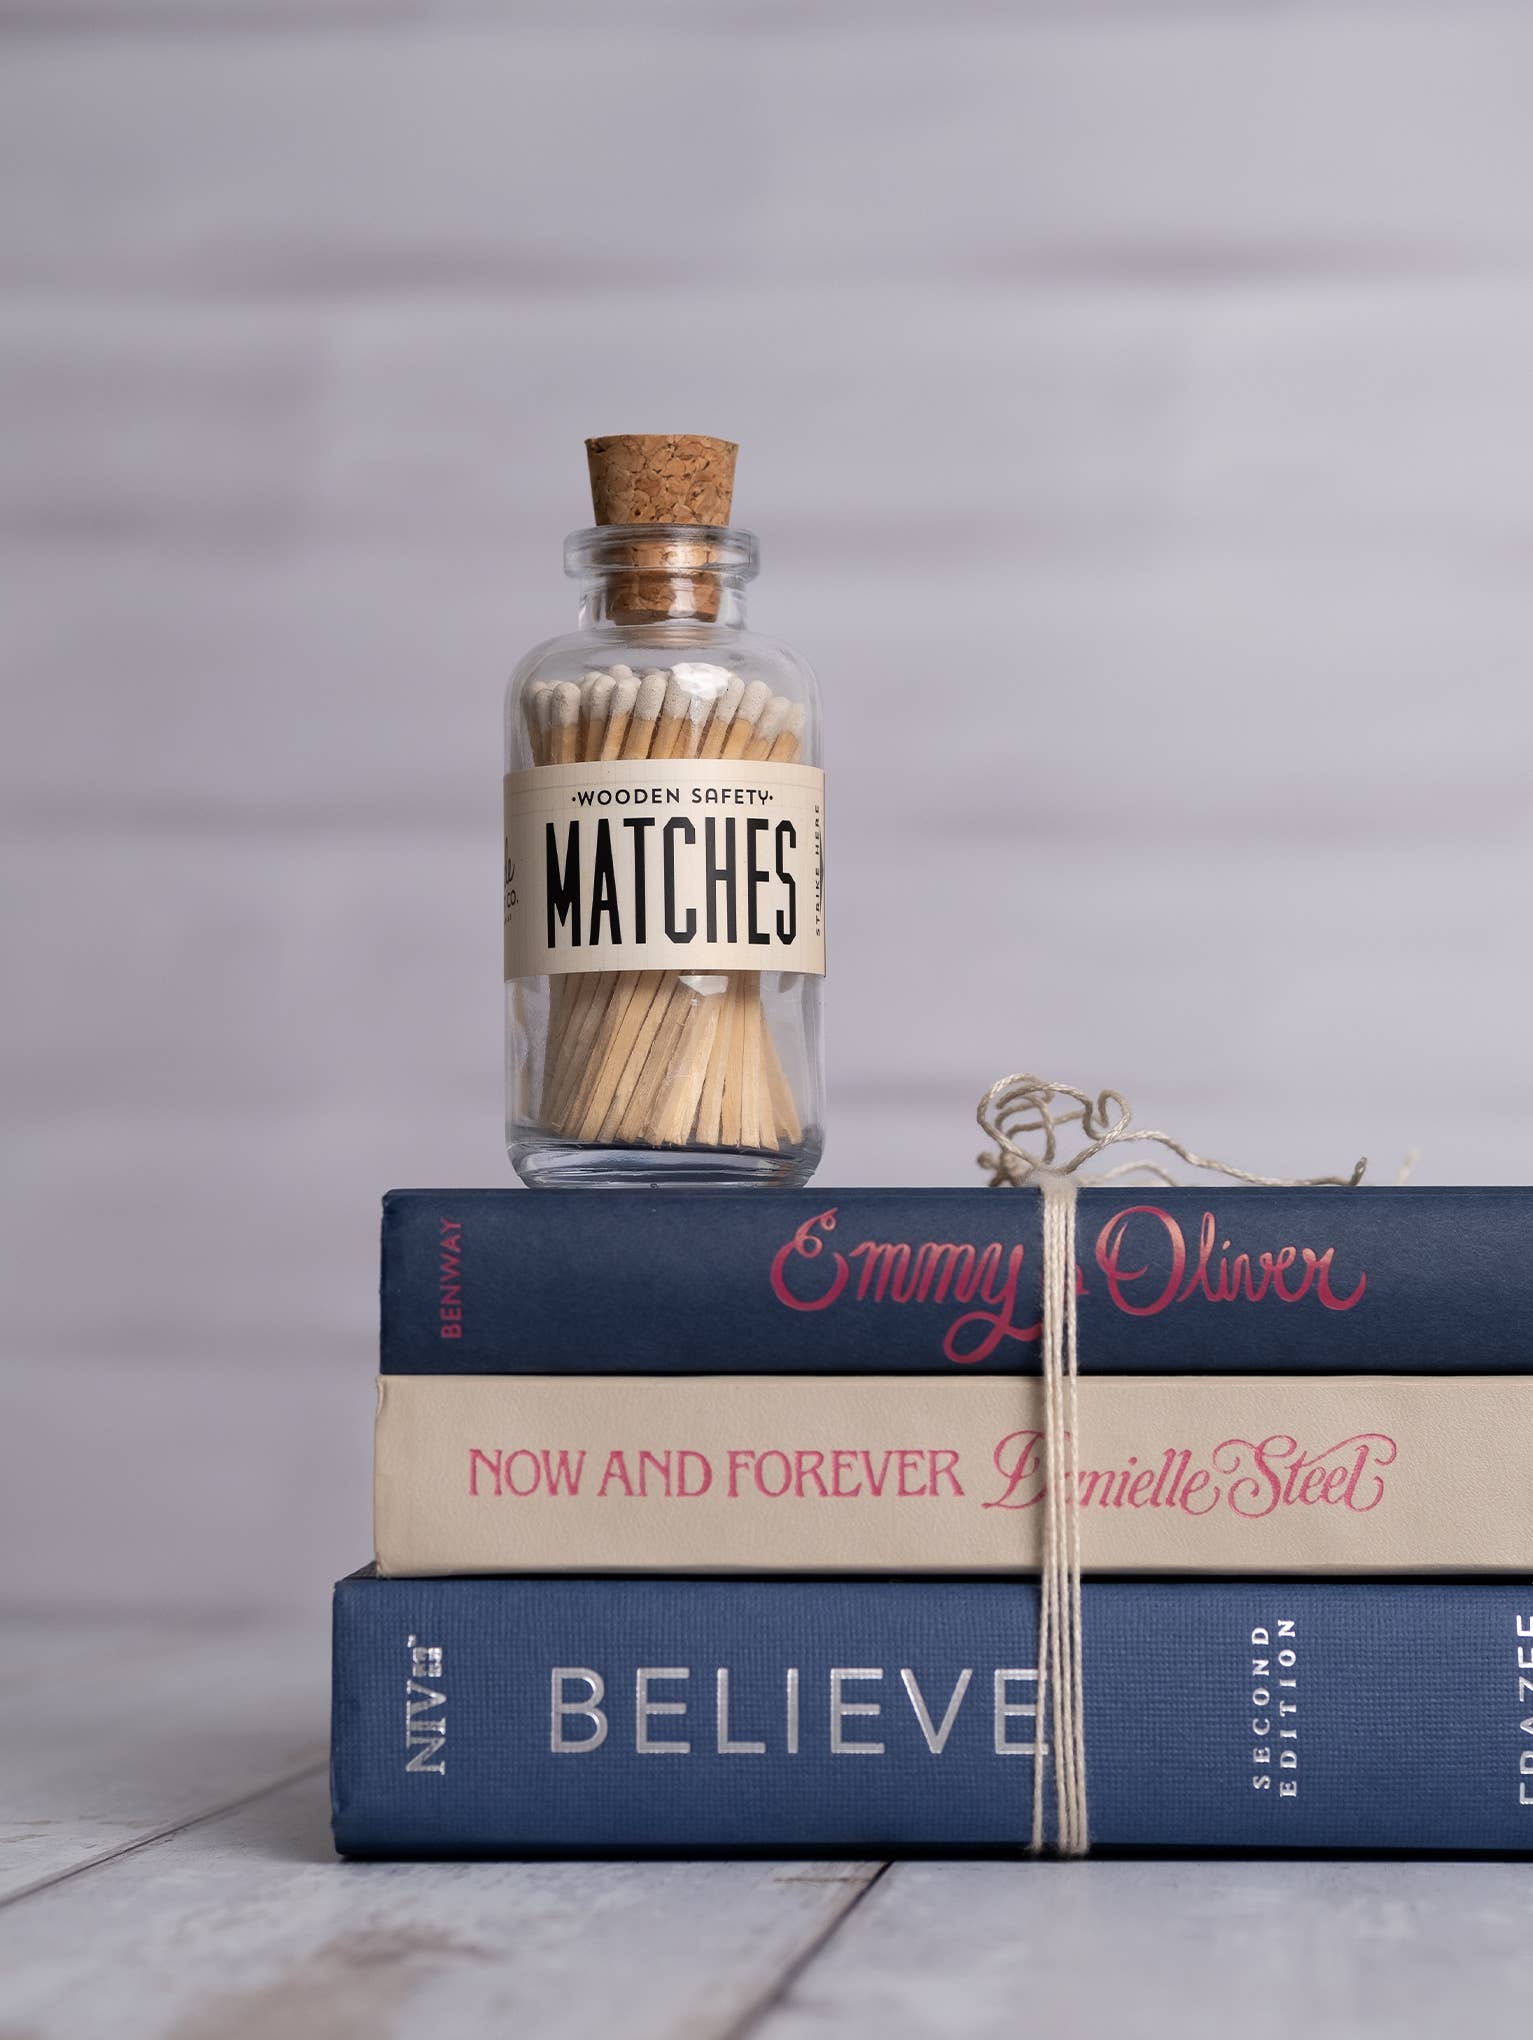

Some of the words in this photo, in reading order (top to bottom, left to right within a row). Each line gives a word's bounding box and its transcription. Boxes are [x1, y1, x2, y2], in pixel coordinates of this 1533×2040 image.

[577, 788, 680, 806] WOODEN
[691, 787, 769, 806] SAFETY
[545, 816, 797, 949] MATCHES
[440, 1216, 463, 1340] BENWAY
[769, 1207, 1044, 1364] Emmy
[1095, 1205, 1367, 1317] Oliver
[468, 1448, 586, 1498] NOW
[597, 1449, 712, 1498] AND
[727, 1449, 965, 1498] FOREVER
[981, 1429, 1220, 1516] Dnielle
[1211, 1433, 1398, 1519] Steel
[405, 1679, 447, 1776] NIV
[550, 1667, 1050, 1755] BELIEVE
[1251, 1627, 1271, 1790] SECOND
[1278, 1619, 1297, 1797] EDITION
